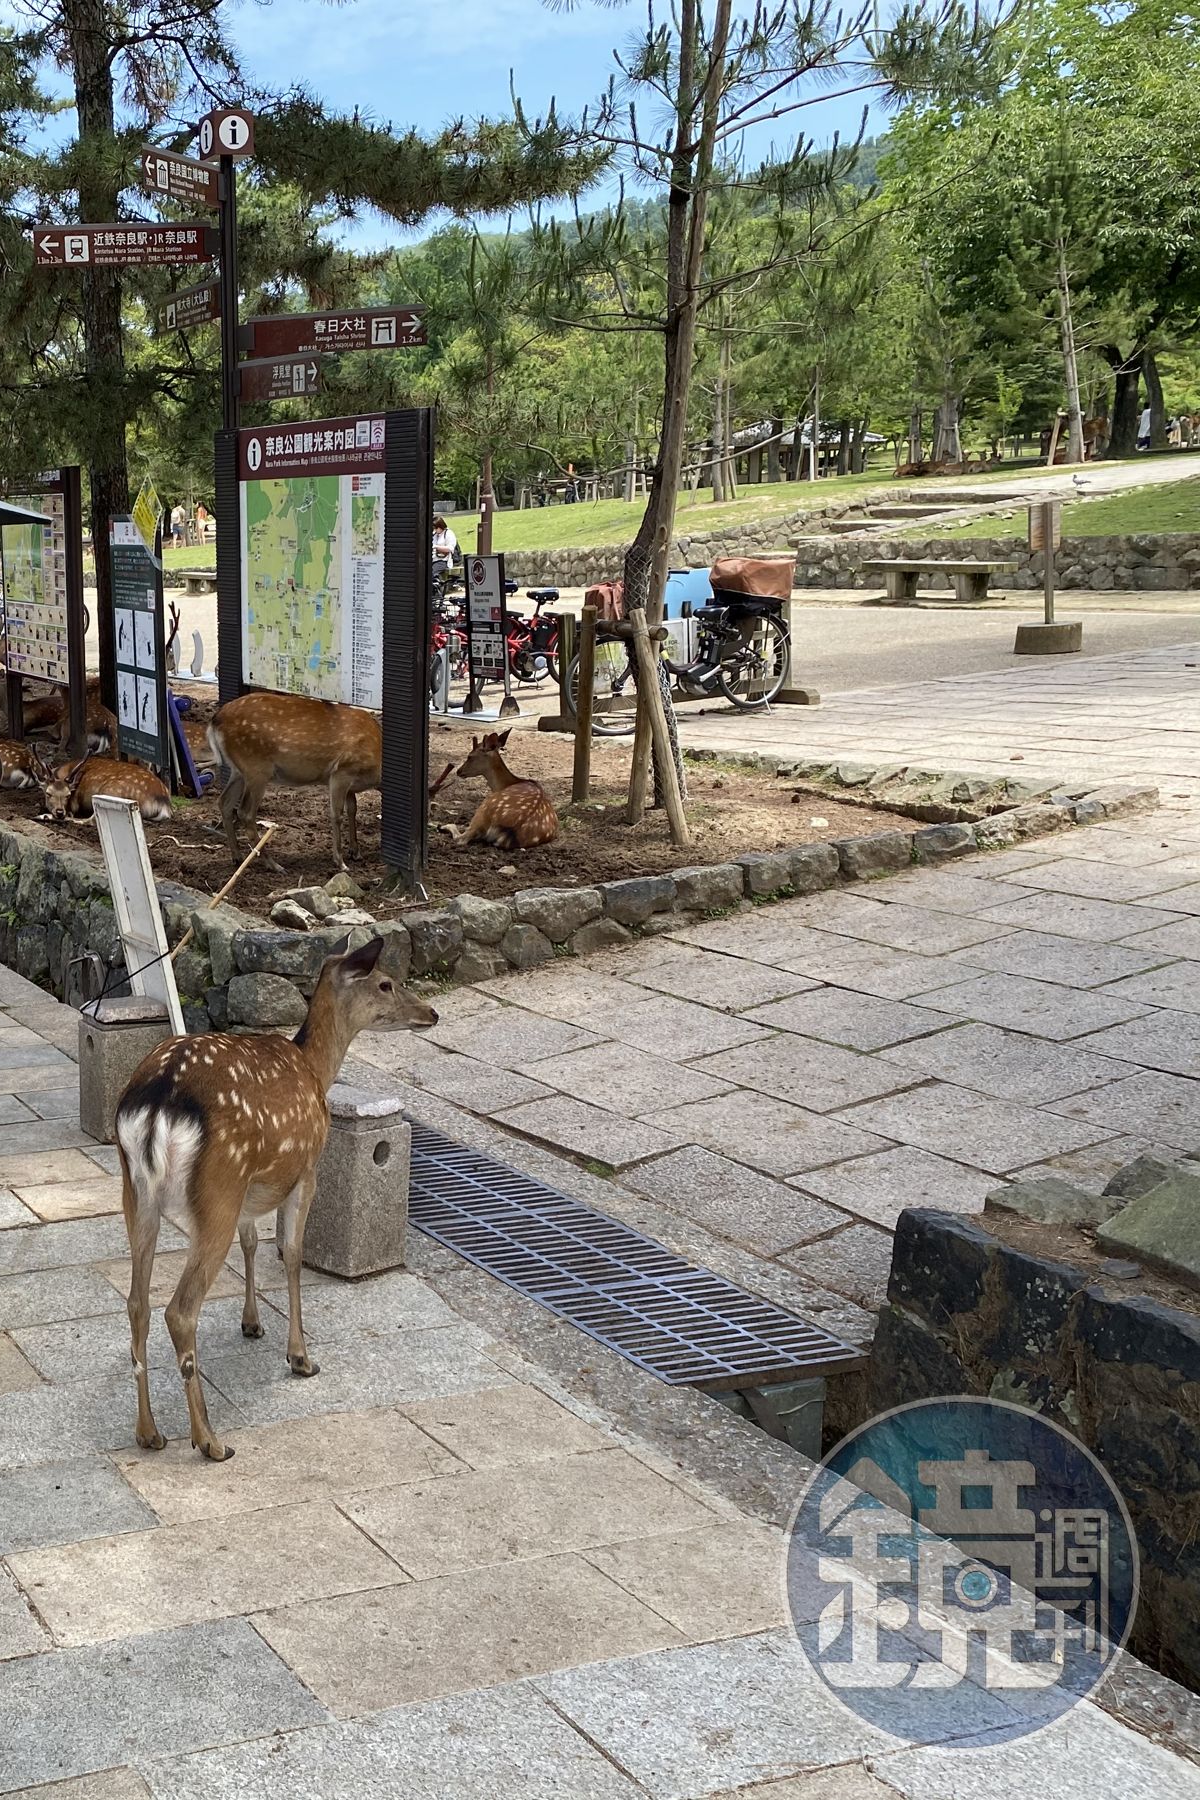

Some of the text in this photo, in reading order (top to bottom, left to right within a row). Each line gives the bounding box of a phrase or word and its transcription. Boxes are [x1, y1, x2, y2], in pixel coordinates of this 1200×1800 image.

[313, 317, 366, 333] 春日大社
[265, 428, 355, 456] 奈良公園観光案内図
